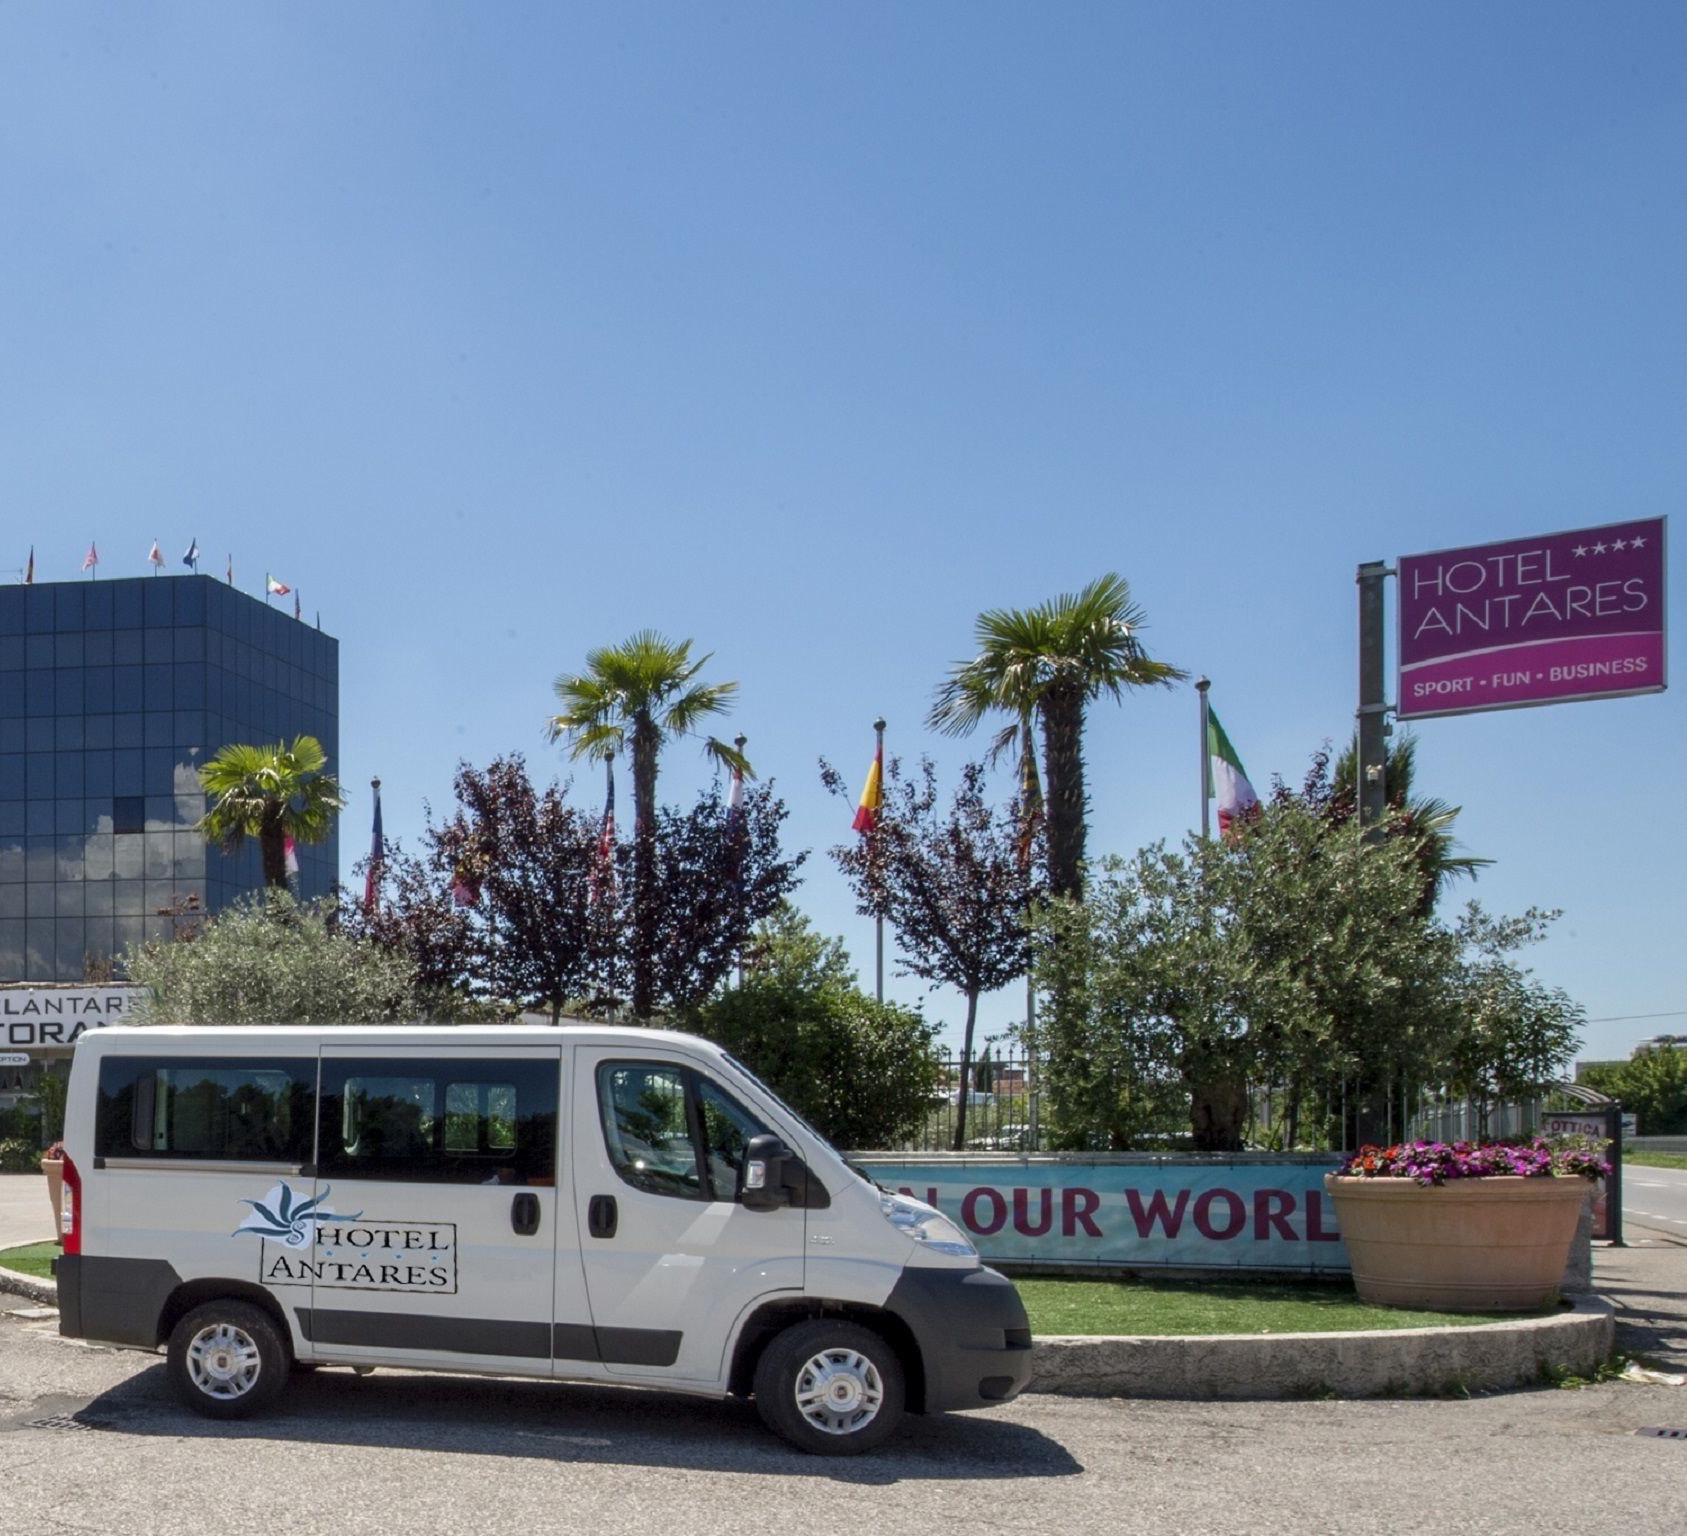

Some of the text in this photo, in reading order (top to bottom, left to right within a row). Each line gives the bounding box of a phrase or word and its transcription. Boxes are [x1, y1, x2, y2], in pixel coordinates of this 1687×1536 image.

[1414, 549, 1572, 600] HOTEL
[1414, 578, 1648, 640] ANTARES
[1413, 657, 1648, 697] SPORT FUN BUSINESS
[960, 1187, 1104, 1238] OUR
[316, 1227, 449, 1251] HOTEL
[267, 1256, 448, 1287] ANTARES
